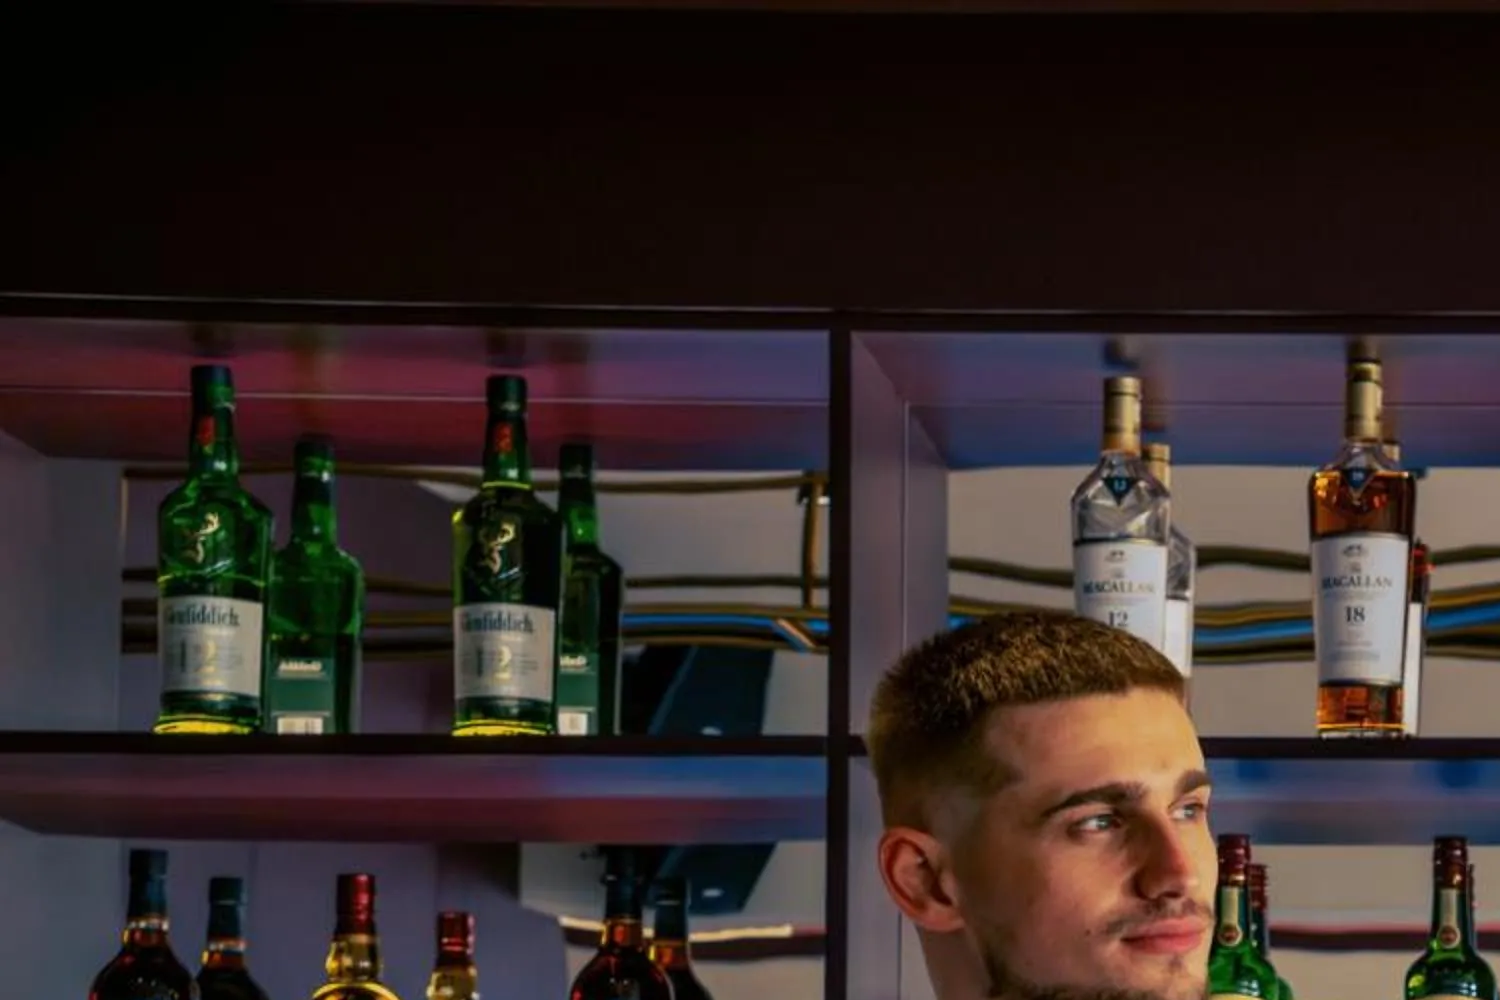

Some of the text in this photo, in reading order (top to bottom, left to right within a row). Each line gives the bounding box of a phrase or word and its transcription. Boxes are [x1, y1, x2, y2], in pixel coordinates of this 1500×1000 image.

[1321, 575, 1394, 590] MACALLAN
[1109, 610, 1129, 627] 12
[1345, 605, 1367, 623] 18
